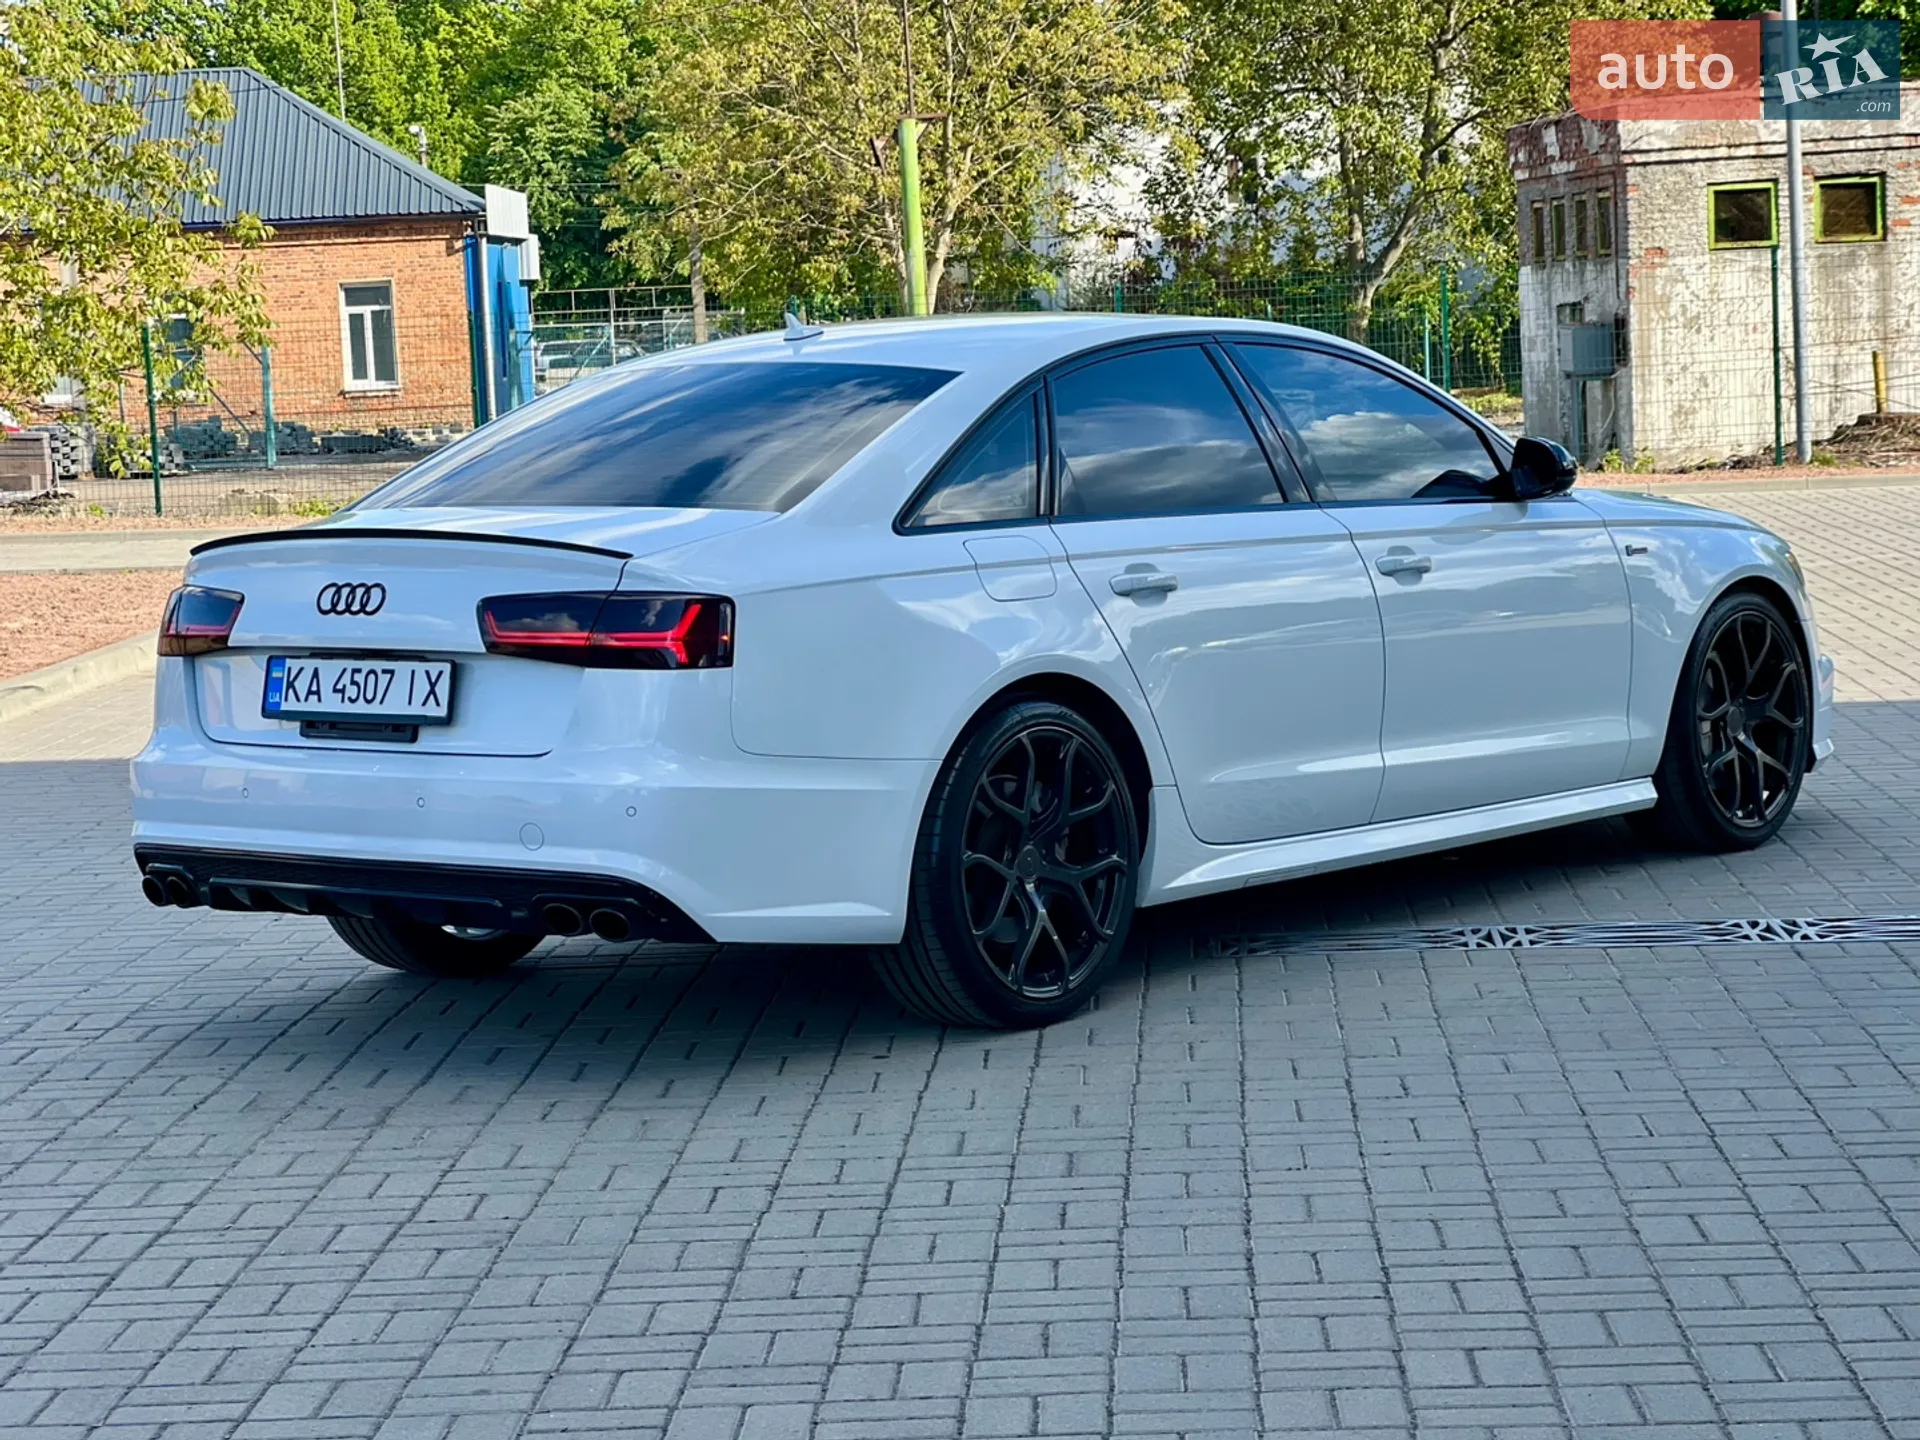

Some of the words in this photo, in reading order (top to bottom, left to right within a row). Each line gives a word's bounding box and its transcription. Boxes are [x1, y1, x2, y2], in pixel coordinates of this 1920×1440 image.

[284, 666, 322, 704] KA
[332, 667, 396, 705] 4507
[408, 669, 444, 708] IX
